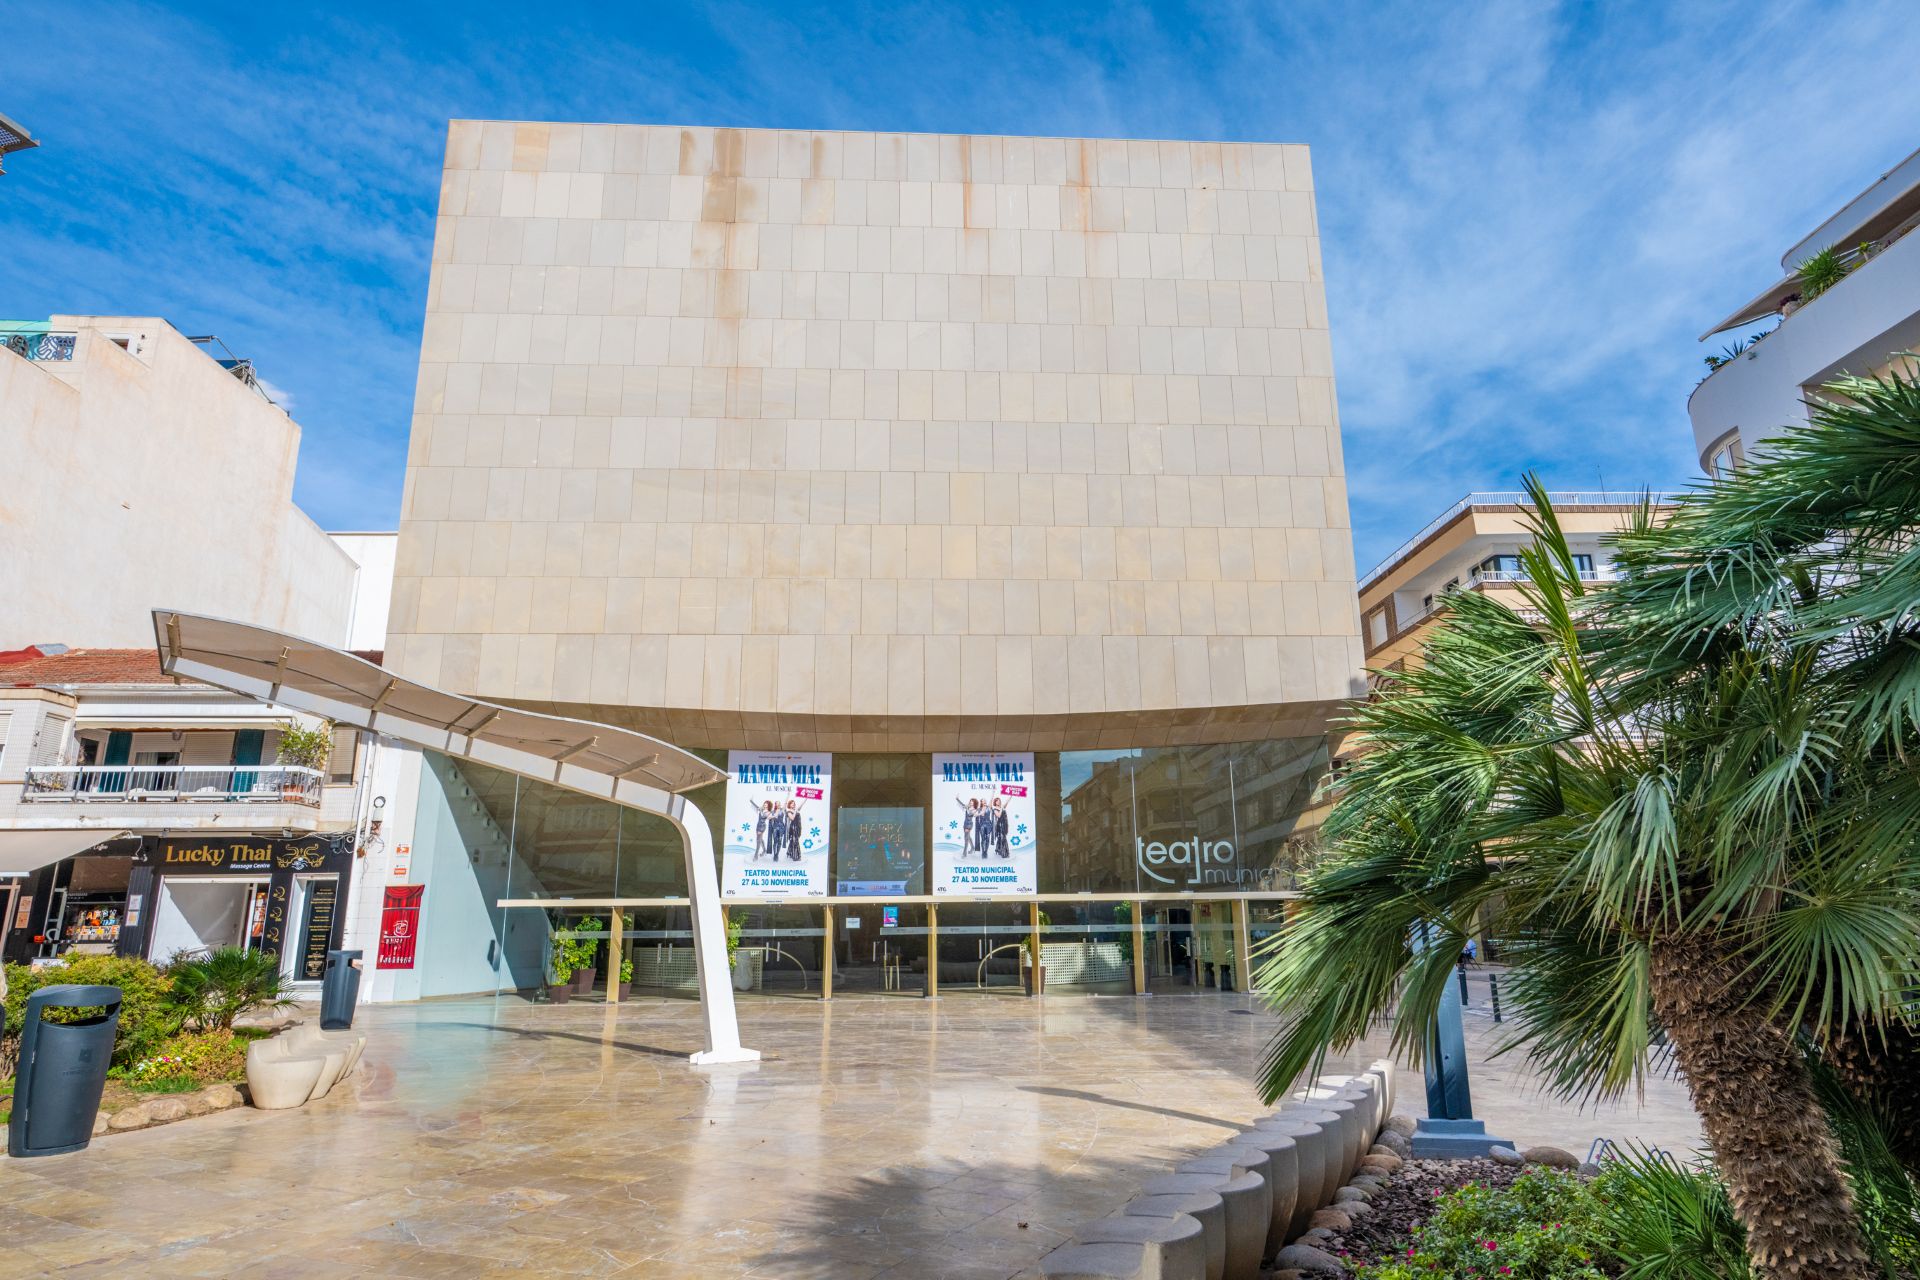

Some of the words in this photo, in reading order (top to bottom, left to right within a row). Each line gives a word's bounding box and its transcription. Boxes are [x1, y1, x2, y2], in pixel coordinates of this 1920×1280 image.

[737, 764, 787, 784] MAMMA
[791, 764, 821, 784] MIA!
[943, 762, 992, 782] MAMMA
[995, 762, 1024, 782] MIA!
[800, 788, 806, 797] 4
[1005, 786, 1010, 794] 4
[165, 844, 225, 866] Lucky
[230, 844, 273, 861] Thai
[1137, 836, 1235, 884] teatro
[744, 869, 770, 877] TEATRO
[771, 869, 808, 877] MUNICIPAL
[954, 866, 980, 874] TEATRO
[981, 866, 1016, 874] MUNICIPAL
[741, 878, 750, 886] 27
[751, 878, 760, 886] AL
[761, 878, 769, 886] 30
[770, 878, 809, 886] NOVIEMBRE
